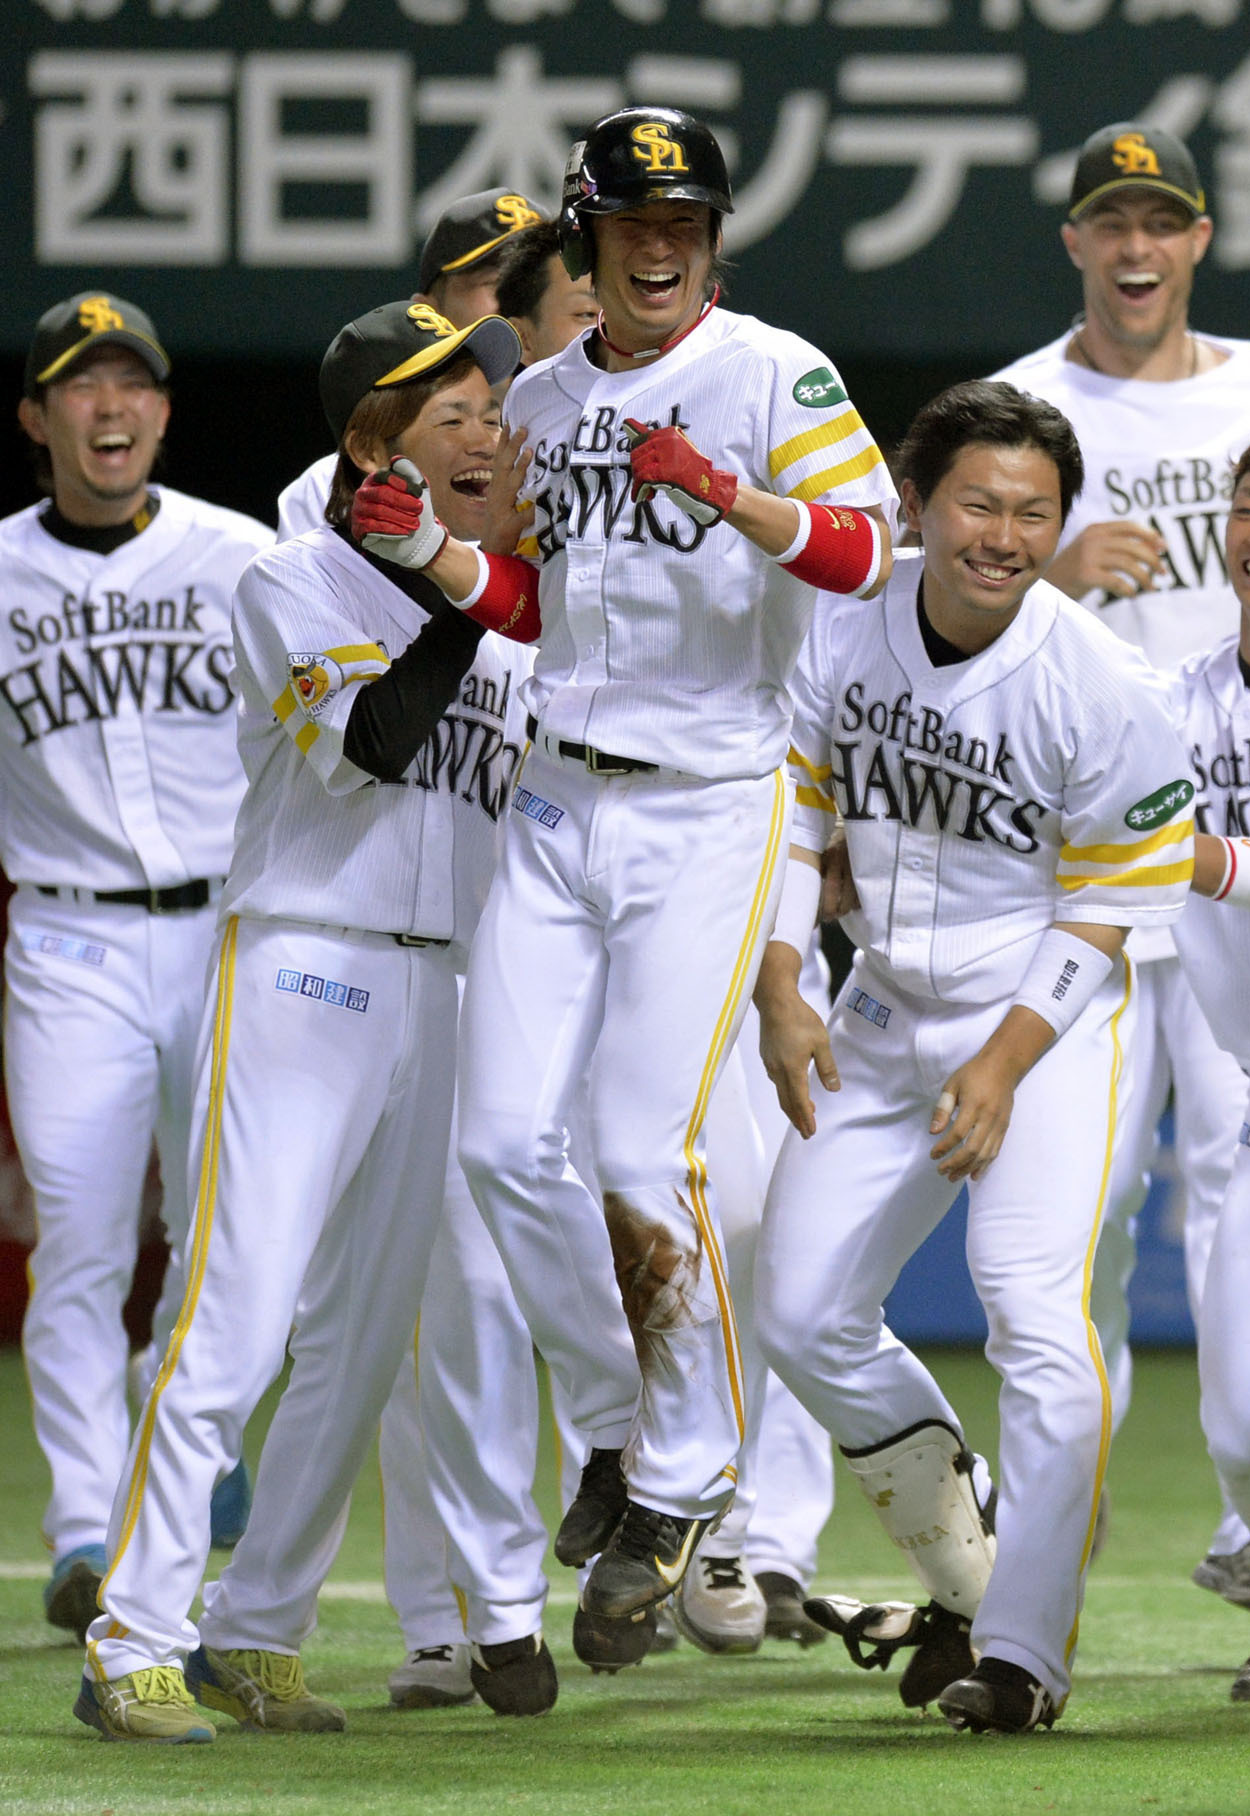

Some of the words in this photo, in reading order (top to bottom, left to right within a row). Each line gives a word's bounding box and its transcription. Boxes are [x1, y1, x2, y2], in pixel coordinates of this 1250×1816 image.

[798, 383, 836, 401] キュー
[1104, 458, 1233, 516] SoftBa
[10, 587, 204, 653] SoftBank
[0, 644, 236, 747] HAWKS
[841, 682, 1013, 786] SoftBank
[834, 742, 1047, 854] HAWKS
[1130, 784, 1187, 825] キューサイ
[275, 969, 370, 1013] 昭和建設
